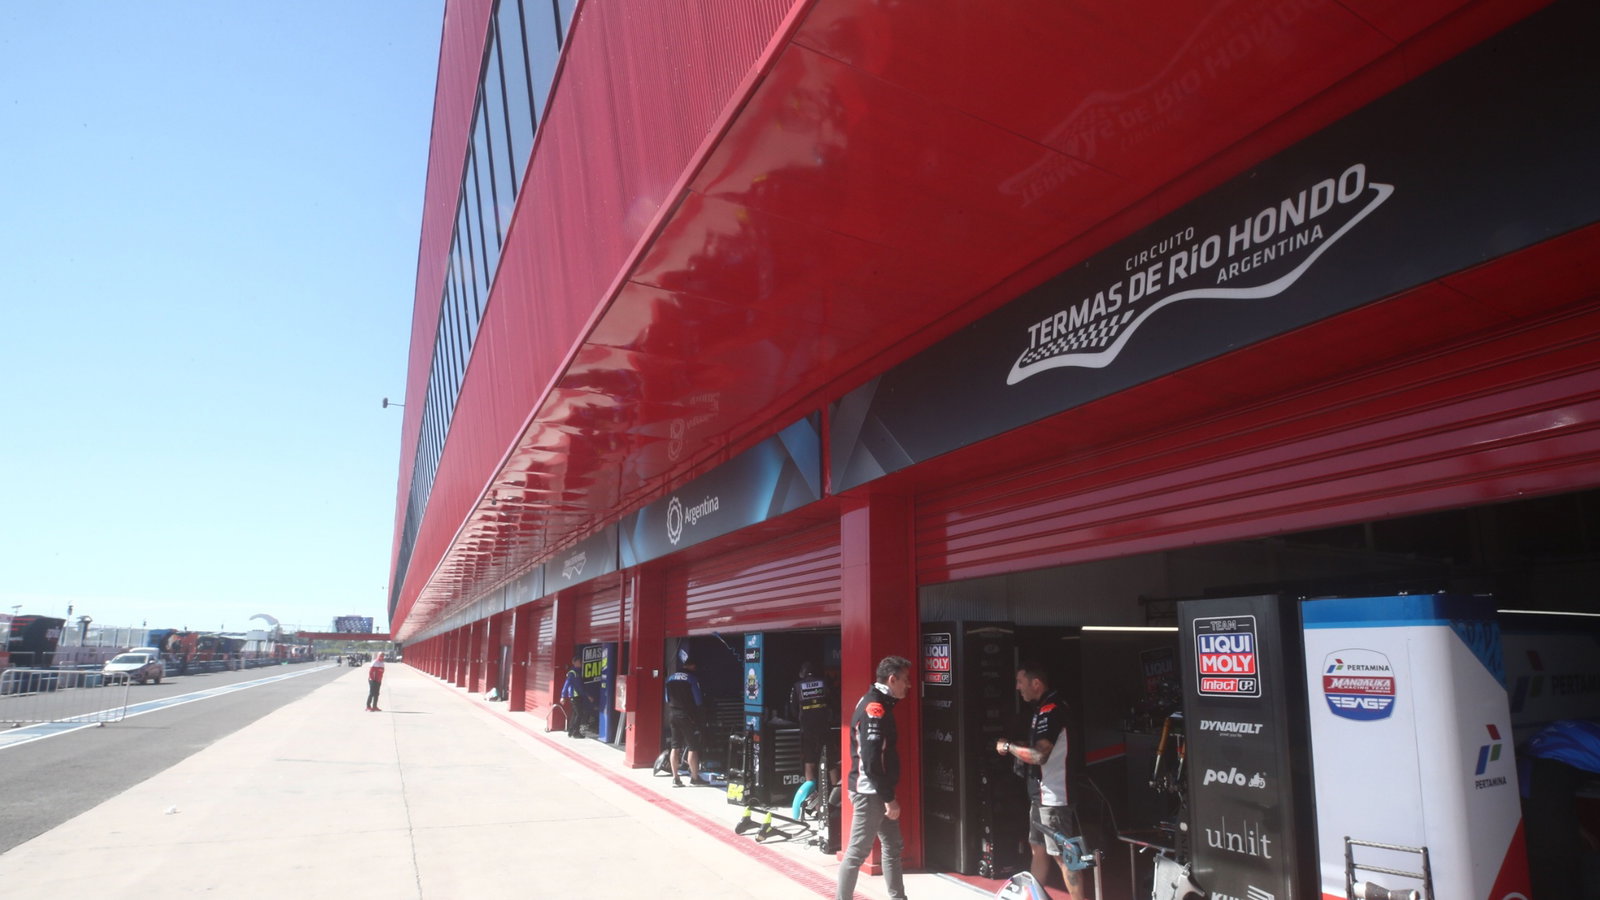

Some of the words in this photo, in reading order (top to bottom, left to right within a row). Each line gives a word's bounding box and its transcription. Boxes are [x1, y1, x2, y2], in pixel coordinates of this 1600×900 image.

[1028, 280, 1123, 350] TERMAS
[1128, 261, 1163, 304] DE
[1227, 163, 1366, 258] HONDO
[1125, 226, 1195, 272] CIRCUITO
[1216, 224, 1324, 285] ARGENTINA
[684, 495, 720, 526] Argentina
[1210, 619, 1237, 632] TEAM
[1200, 635, 1251, 654] LIQUI
[1202, 654, 1253, 673] MOLY
[1200, 720, 1263, 735] DYNAVOLT
[1203, 767, 1247, 787] polo
[1475, 776, 1507, 790] PERTAMINA
